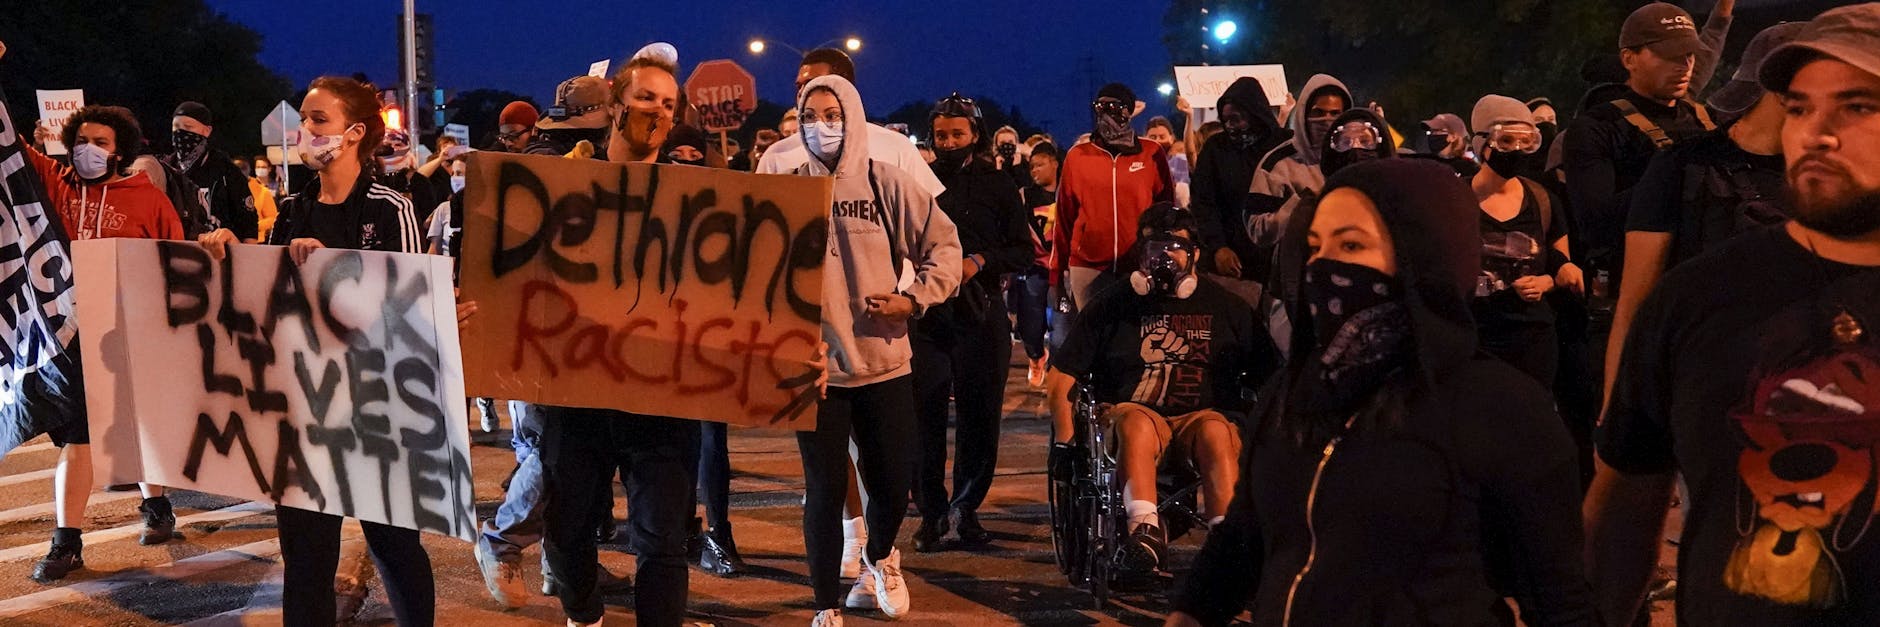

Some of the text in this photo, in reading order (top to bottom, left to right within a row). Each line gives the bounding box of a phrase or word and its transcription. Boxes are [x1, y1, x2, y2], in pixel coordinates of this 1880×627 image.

[45, 101, 78, 111] BLACK
[696, 84, 744, 107] STOP
[699, 98, 743, 116] OLICE
[49, 118, 66, 127] LIV
[832, 200, 880, 227] ASHER
[158, 241, 439, 372] BLACK
[1140, 314, 1213, 338] RAGE AGAINST
[1186, 329, 1212, 340] THE
[197, 323, 447, 450] LIVES
[182, 411, 477, 544] MATTER
